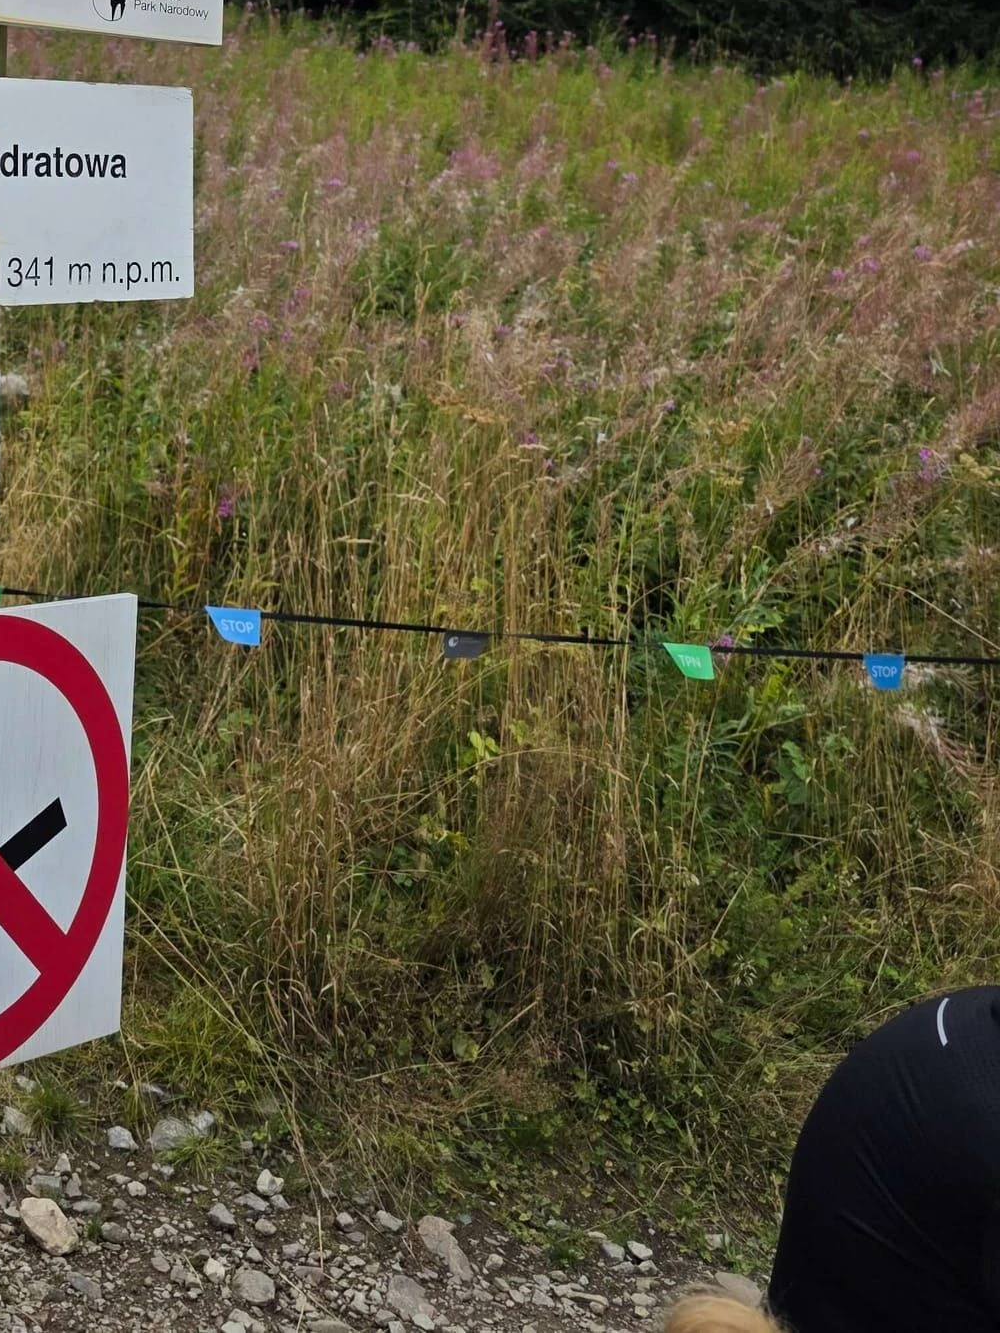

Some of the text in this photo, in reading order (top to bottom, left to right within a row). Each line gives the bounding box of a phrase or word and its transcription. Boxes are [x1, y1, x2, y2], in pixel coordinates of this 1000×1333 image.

[160, 0, 209, 21] Narodowy
[68, 264, 92, 284] m
[101, 260, 180, 290] n.p.m.
[220, 619, 254, 634] STOP
[677, 654, 702, 668] TPN
[872, 666, 897, 678] STOP
